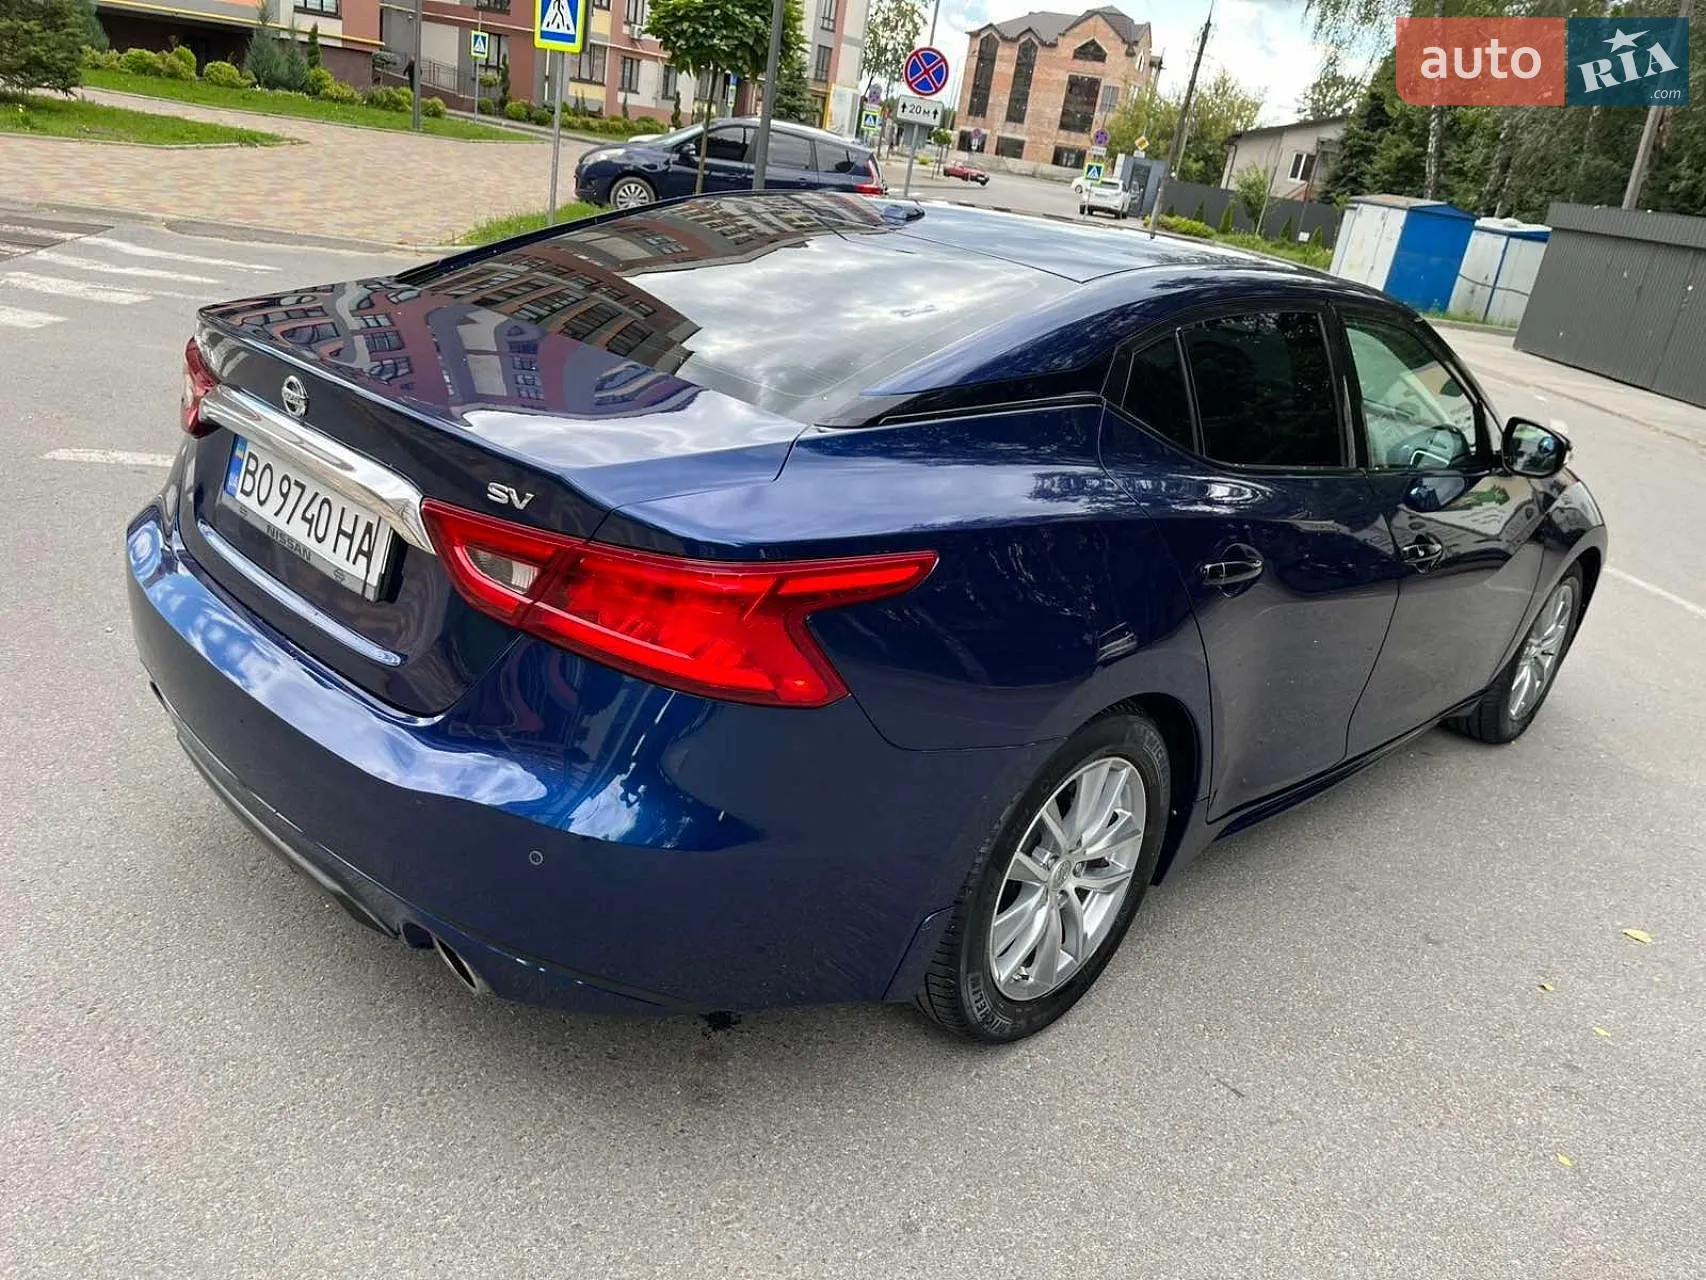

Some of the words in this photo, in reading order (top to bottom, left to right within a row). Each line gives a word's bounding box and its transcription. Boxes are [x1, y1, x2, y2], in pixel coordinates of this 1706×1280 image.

[909, 104, 921, 114] 20
[240, 451, 274, 507] BO
[274, 474, 333, 543] 9740
[333, 507, 374, 569] HA
[487, 482, 535, 510] SV
[266, 524, 311, 563] NISSAN
